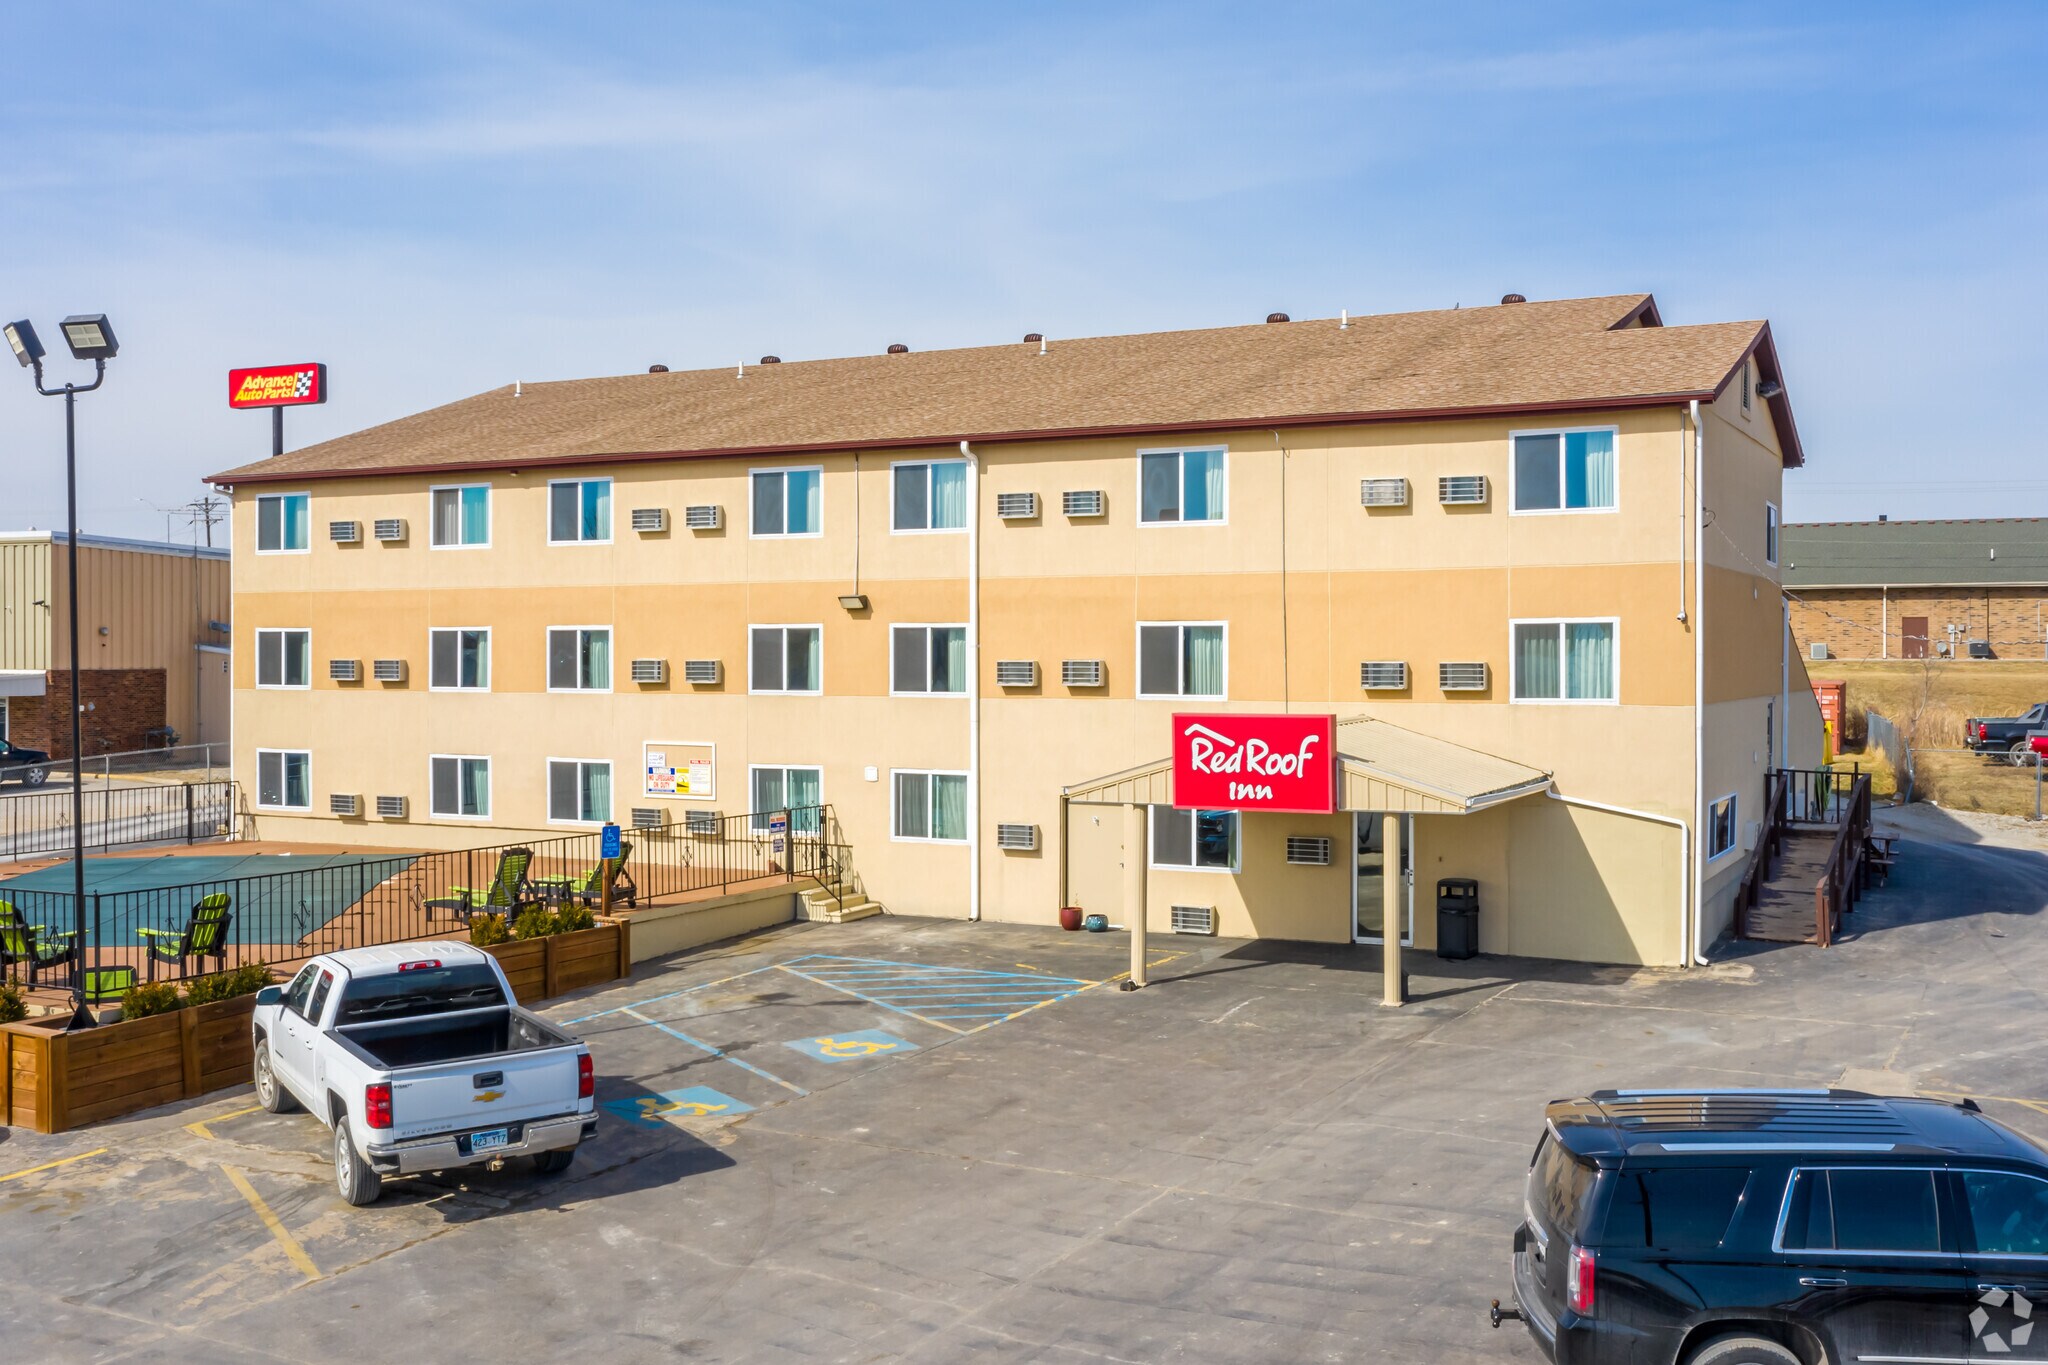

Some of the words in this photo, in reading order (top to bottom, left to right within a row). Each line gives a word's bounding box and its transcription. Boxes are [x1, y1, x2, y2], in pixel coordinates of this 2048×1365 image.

[242, 376, 294, 389] Advance
[234, 390, 262, 401] Auto
[263, 387, 291, 399] Parts
[1191, 737, 1244, 774] Red
[1246, 734, 1320, 779] Roof
[473, 1137, 487, 1147] 423
